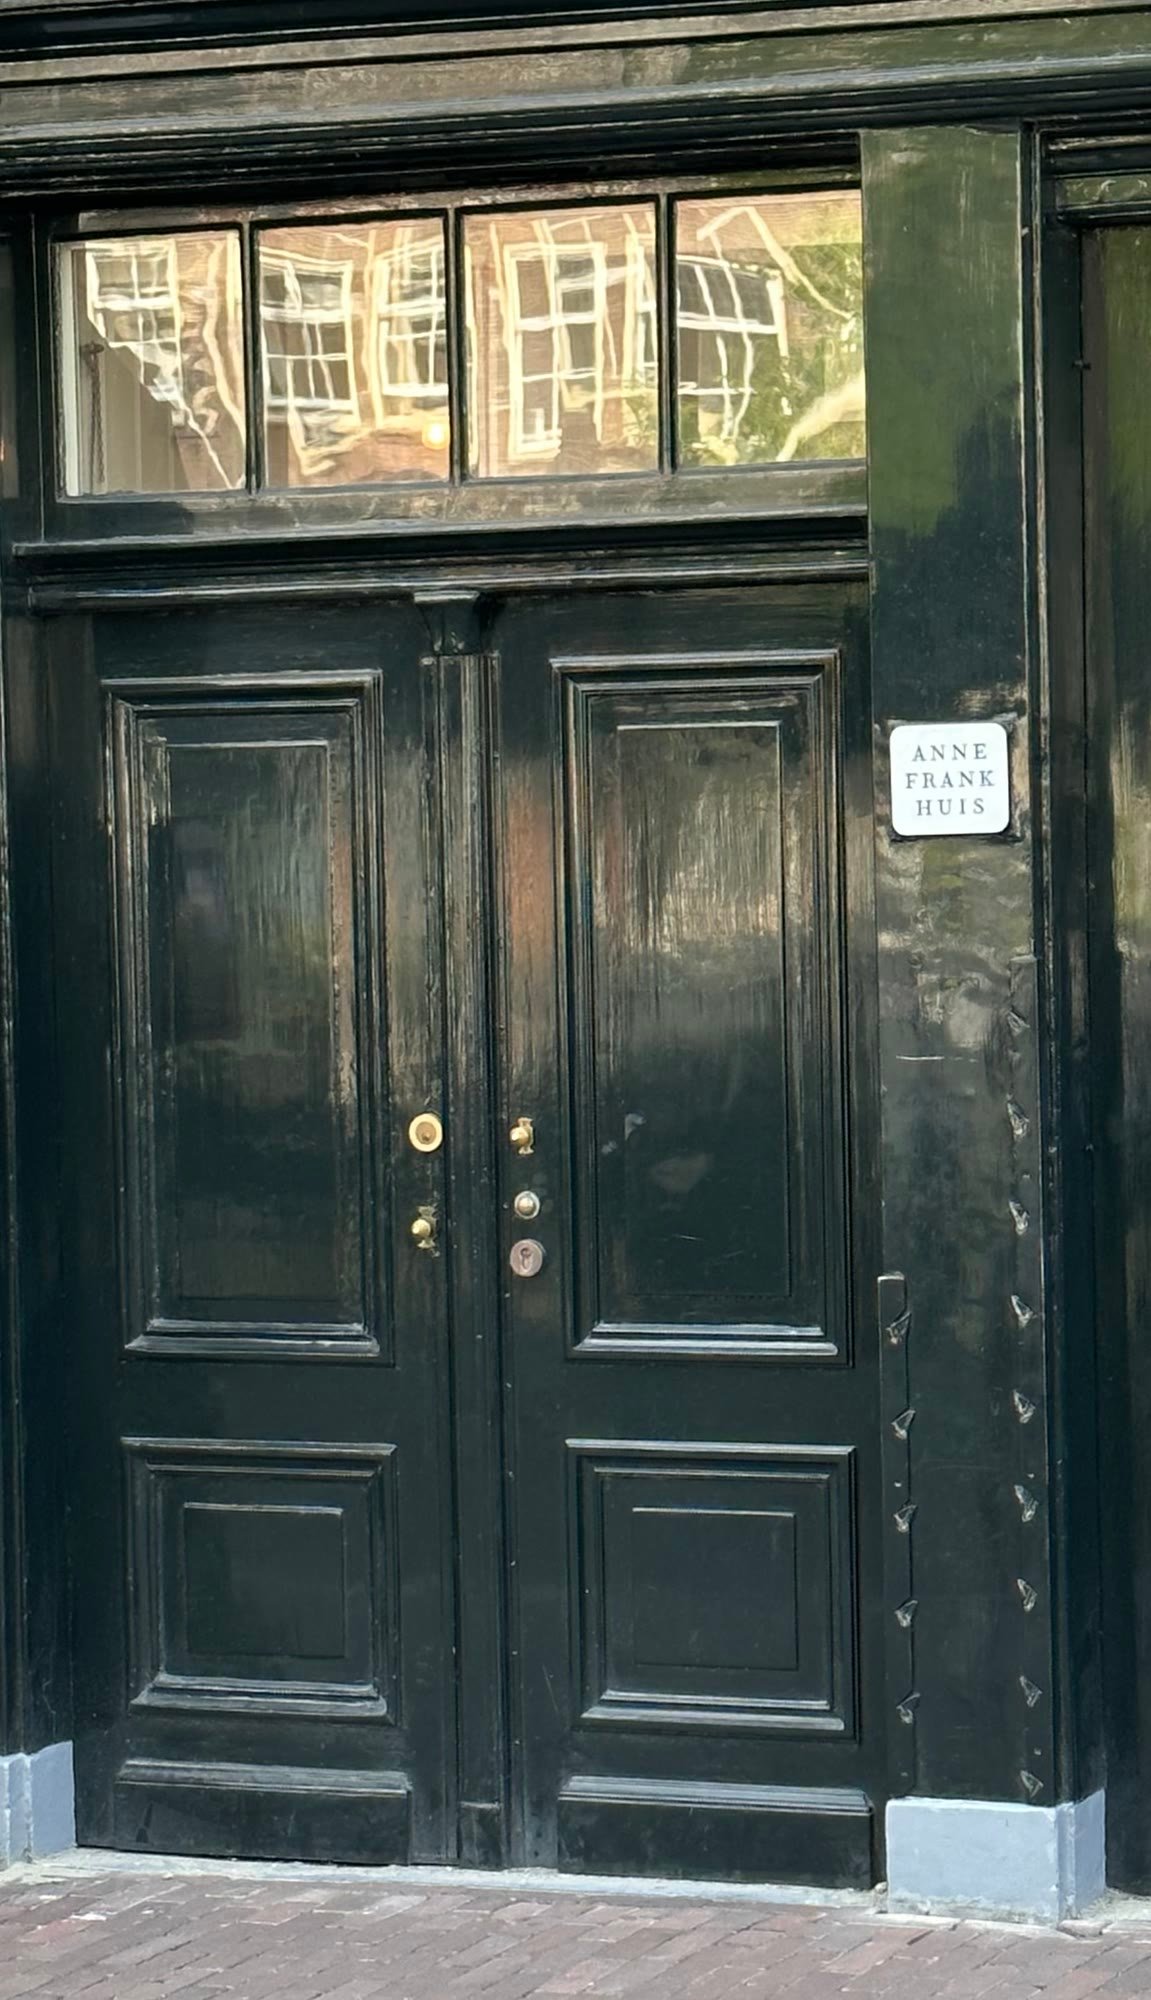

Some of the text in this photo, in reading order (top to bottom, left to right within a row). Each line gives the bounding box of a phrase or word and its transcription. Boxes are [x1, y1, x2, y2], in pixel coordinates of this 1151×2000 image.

[912, 743, 987, 762] ANNE
[905, 770, 995, 789] FRANK
[916, 798, 985, 816] HUIS
